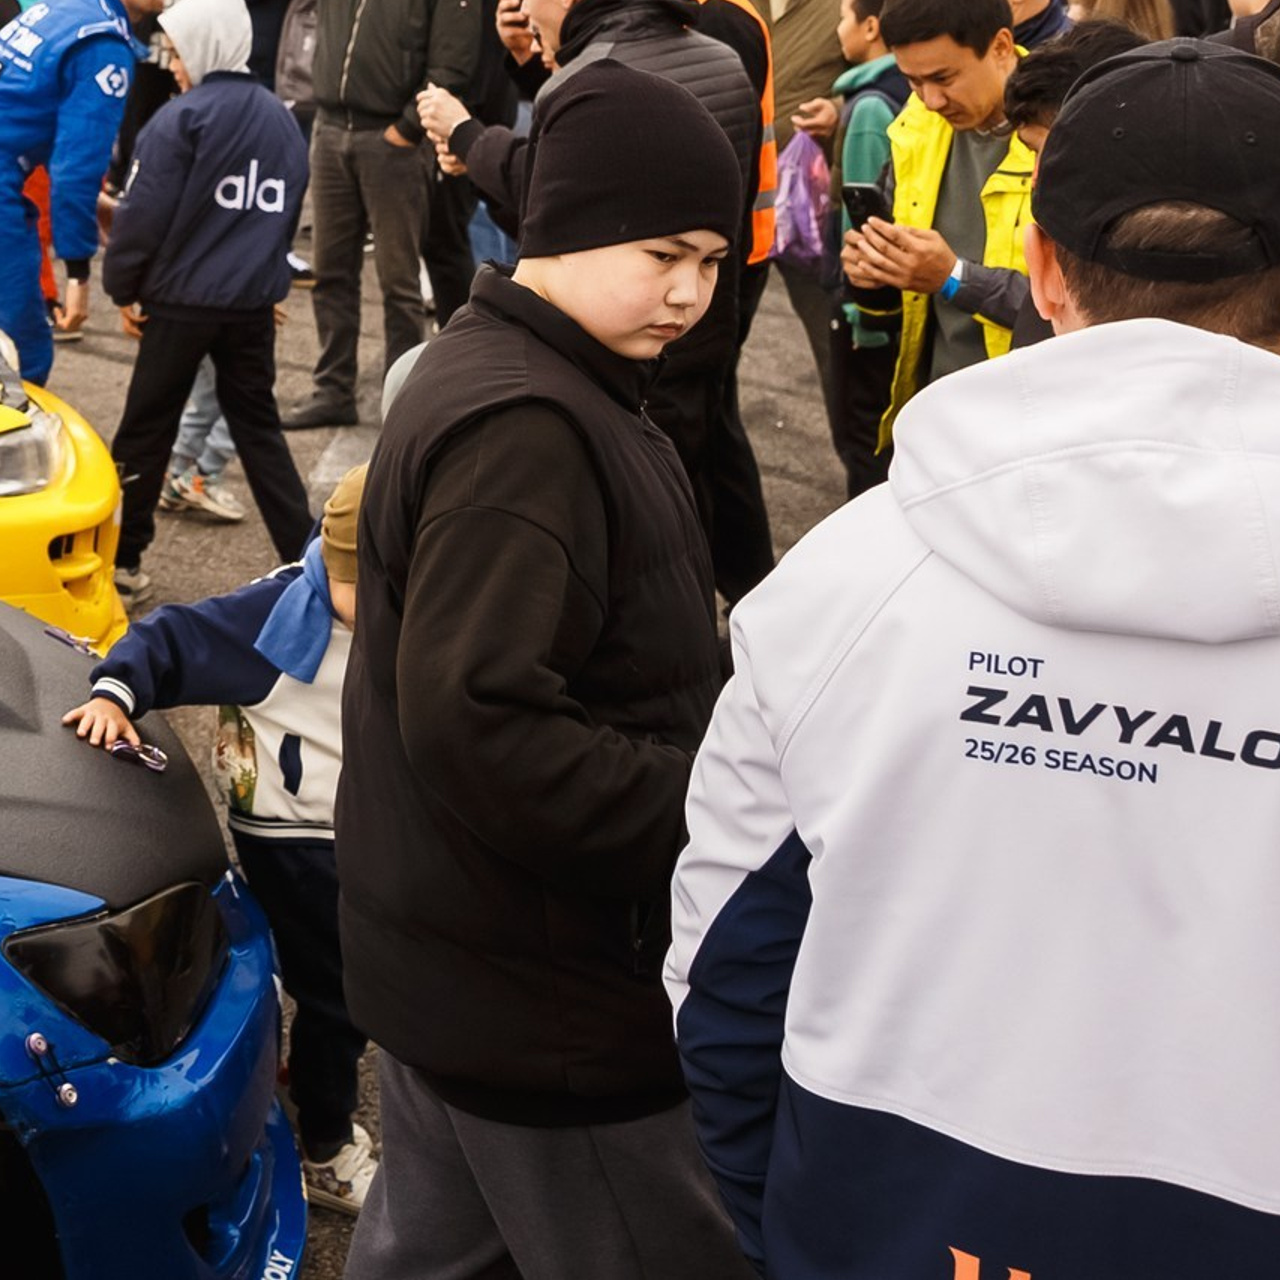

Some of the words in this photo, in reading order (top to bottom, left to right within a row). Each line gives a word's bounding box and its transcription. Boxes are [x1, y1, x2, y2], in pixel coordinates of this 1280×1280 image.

[214, 159, 285, 213] ala
[969, 651, 1045, 679] PILOT
[959, 685, 1280, 770] ZAVYALO
[965, 738, 1037, 766] 25/26
[1044, 749, 1159, 784] SEASON
[261, 1249, 294, 1280] OLY
